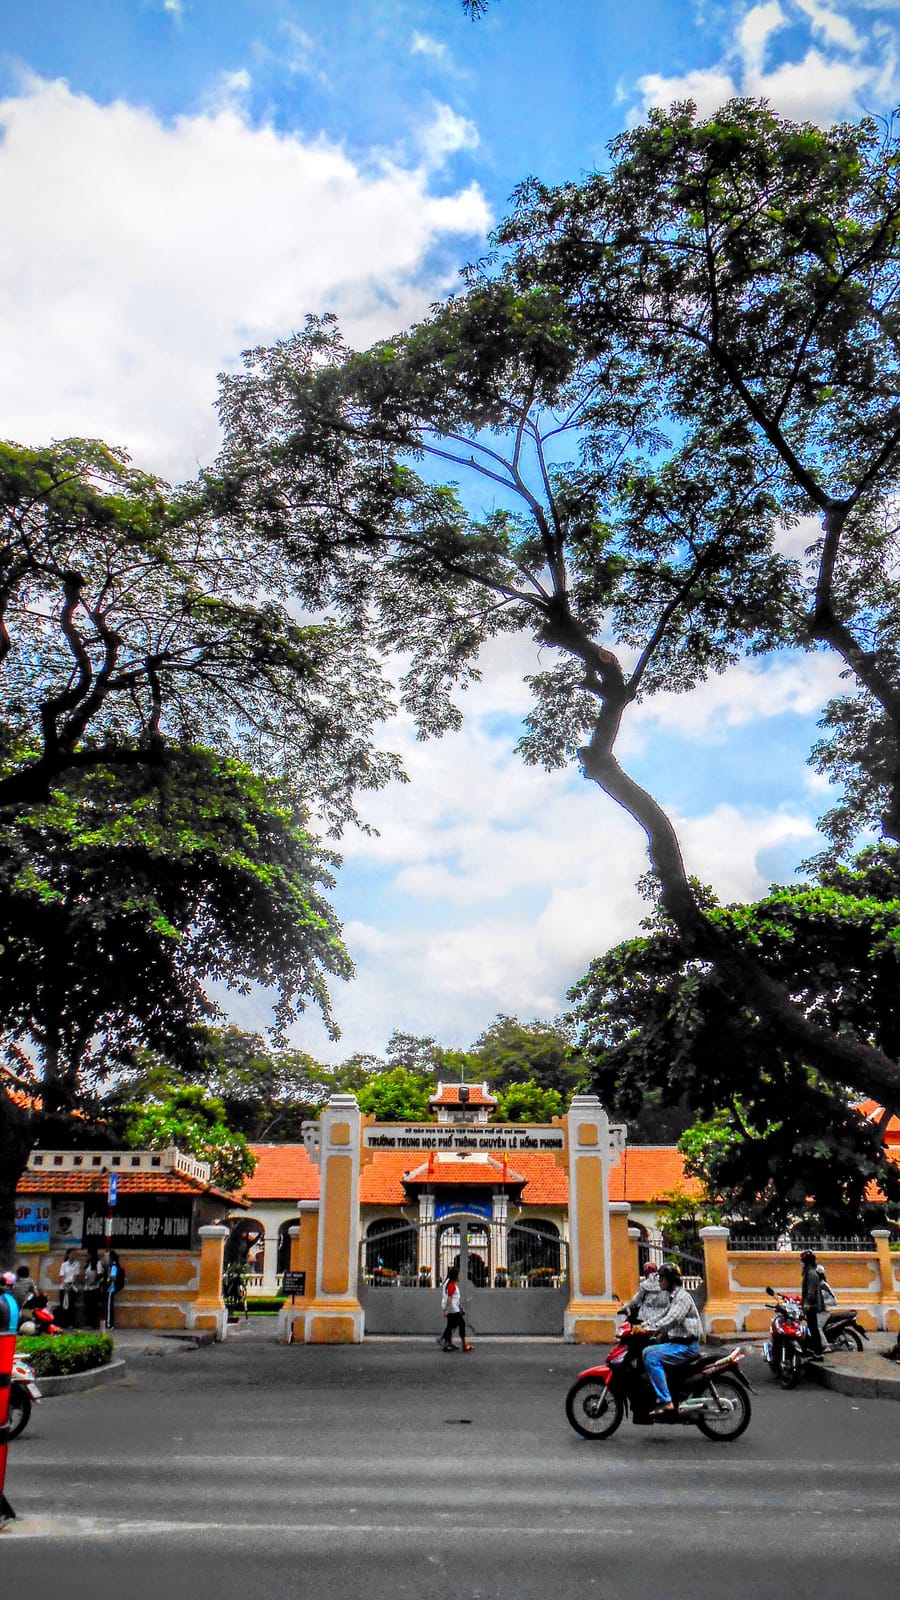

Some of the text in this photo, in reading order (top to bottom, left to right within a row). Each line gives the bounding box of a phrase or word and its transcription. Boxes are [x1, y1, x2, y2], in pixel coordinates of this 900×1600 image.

[368, 1134, 396, 1147] TRƯỜNG
[397, 1137, 420, 1147] TRUNG
[421, 1137, 436, 1149] HỌC
[454, 1136, 477, 1147] THÔNG
[479, 1136, 507, 1148] CHUYÊN
[509, 1136, 517, 1148] LÊ
[520, 1135, 538, 1148] HỒNG
[540, 1138, 563, 1148] PHONG
[35, 1207, 50, 1219] 10
